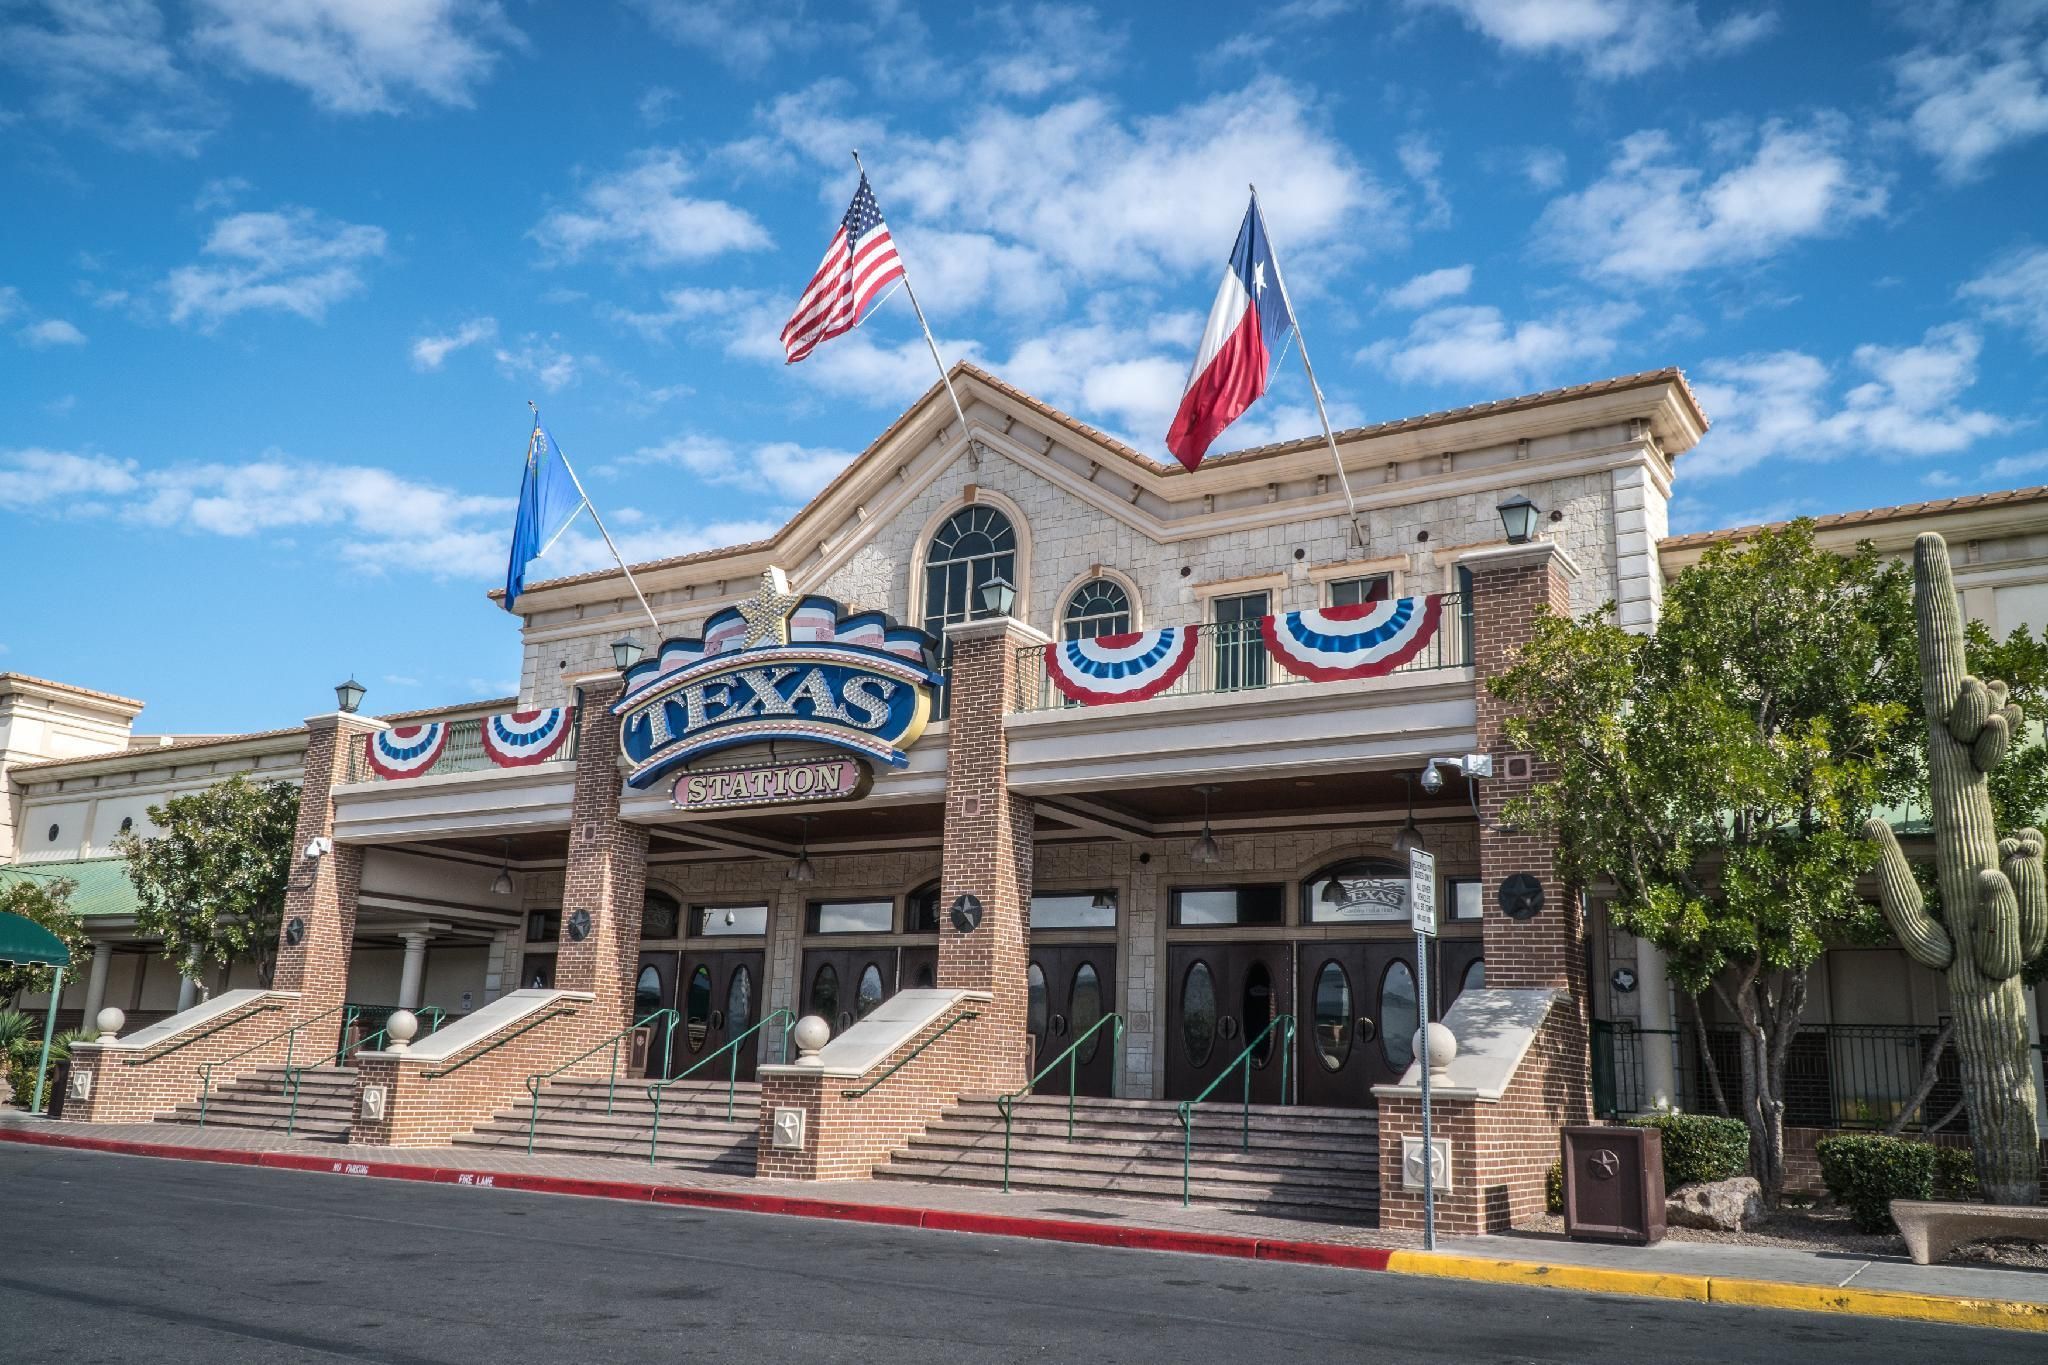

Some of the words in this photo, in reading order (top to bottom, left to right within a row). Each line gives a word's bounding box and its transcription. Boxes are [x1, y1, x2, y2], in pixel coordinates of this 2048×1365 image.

[631, 667, 898, 749] TEXAS
[687, 764, 843, 803] STATION
[332, 1163, 342, 1172] NO
[345, 1164, 369, 1175] PARKING
[458, 1174, 472, 1185] FIRE
[476, 1176, 494, 1187] LANE
